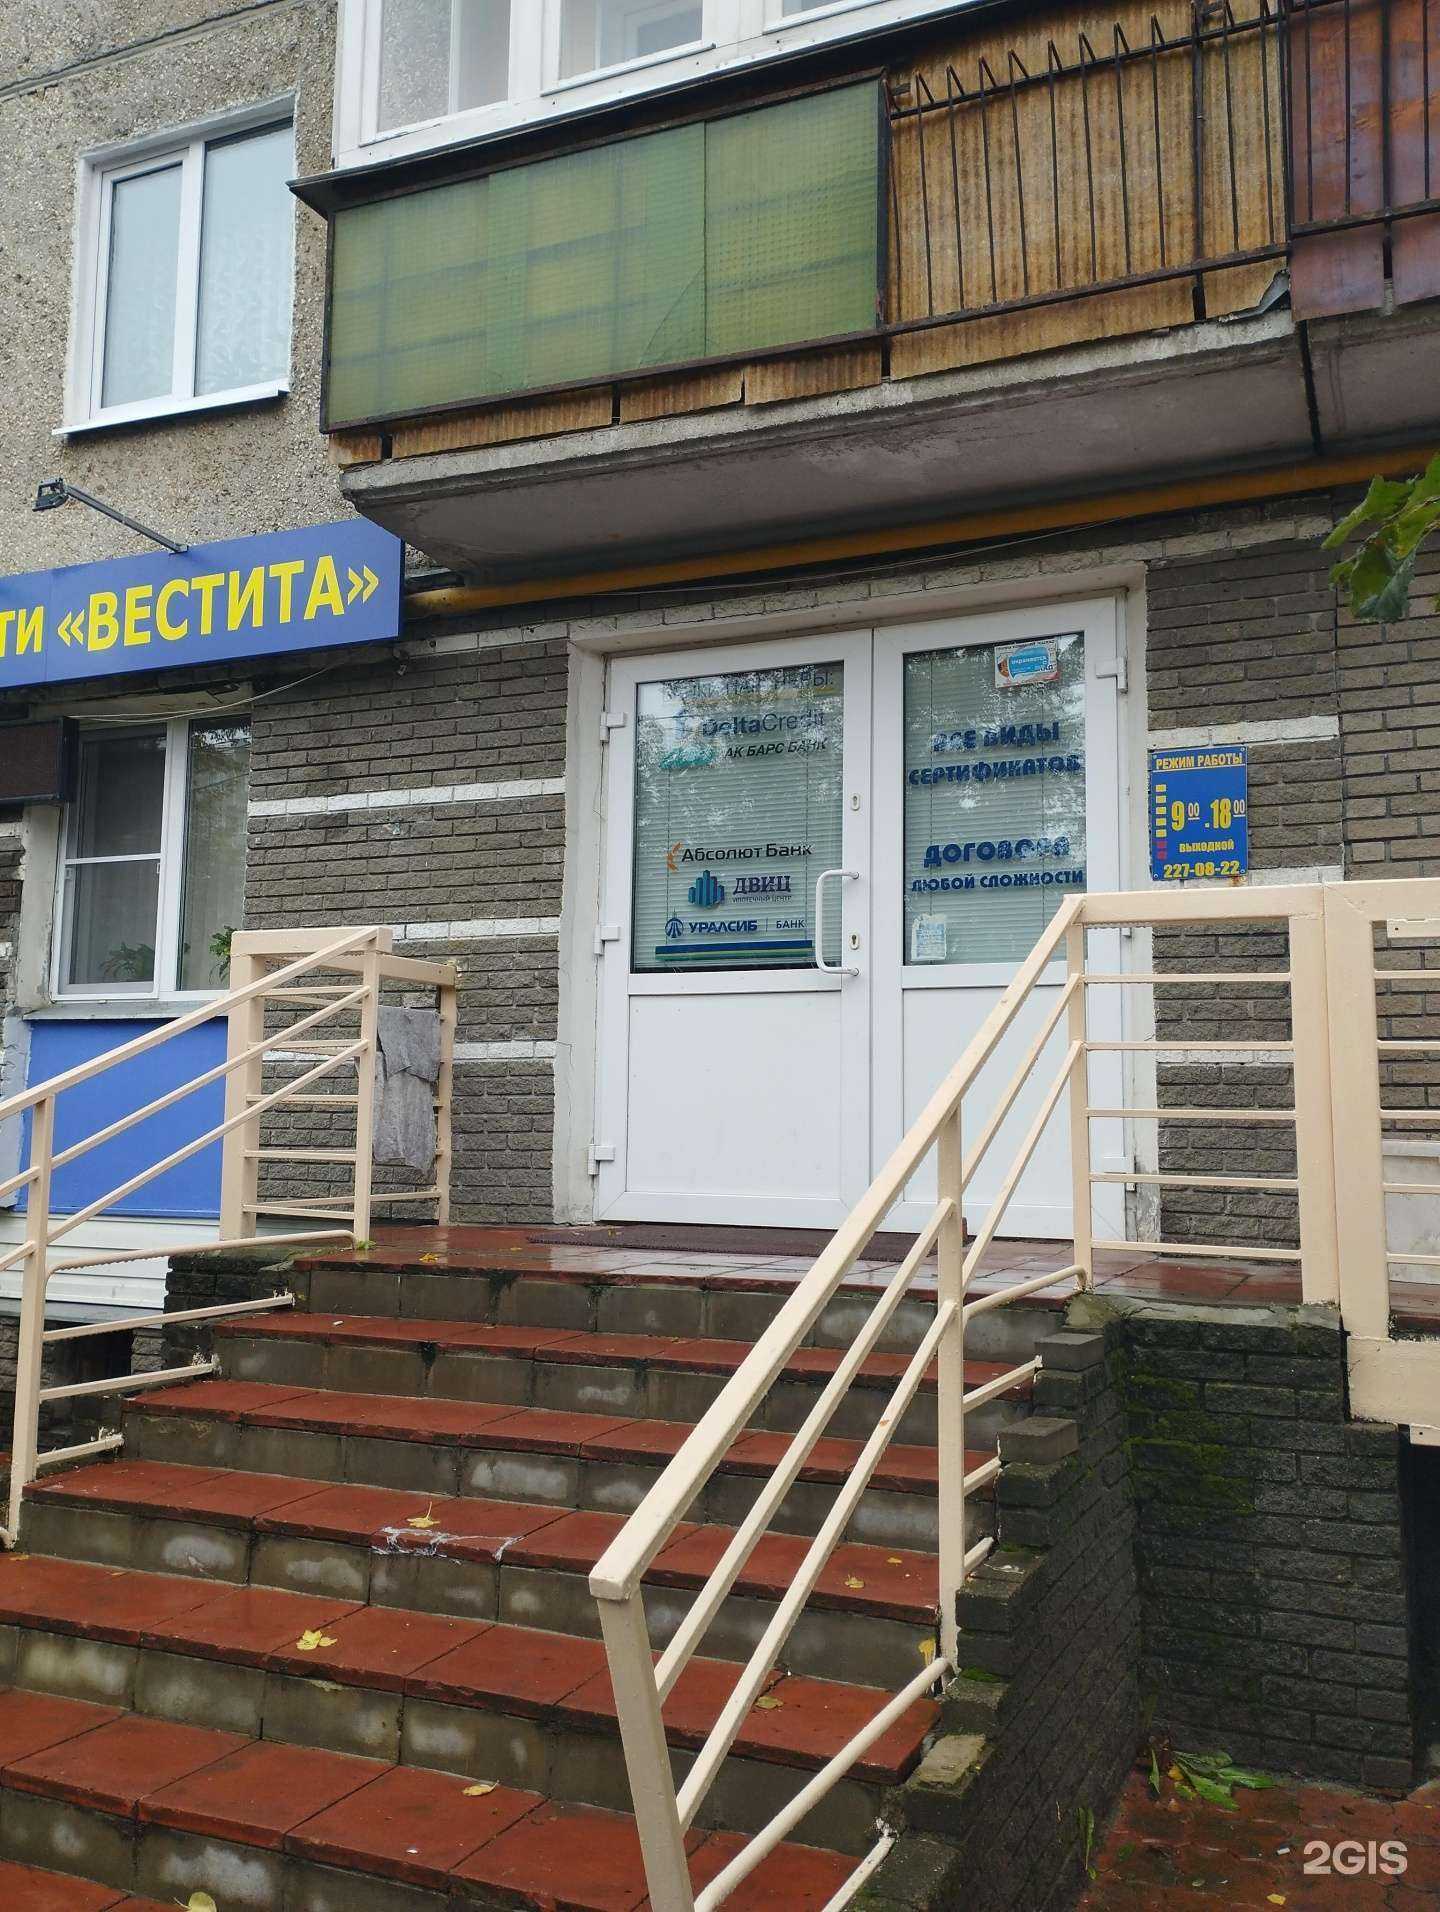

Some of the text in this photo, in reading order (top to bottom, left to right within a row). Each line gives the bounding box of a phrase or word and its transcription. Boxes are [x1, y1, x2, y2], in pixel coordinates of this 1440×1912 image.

[57, 555, 379, 652] «ВЕСТИТА»
[984, 721, 1060, 748] ВИДЫ
[746, 742, 784, 756] БАРС
[788, 738, 828, 753] БАНК
[908, 754, 1082, 786] СЕРТИФИКАТОВ
[1155, 752, 1243, 770] РЕЖИМ РАБОТЫ
[681, 843, 813, 862] Абсолют Банк
[1163, 861, 1240, 878] 227-08-22
[733, 875, 791, 895] ДВИЦ
[911, 870, 1083, 892] ЛЮБОЙ СЛОЖНОСТИ
[688, 919, 806, 933] УРАЛСИБ БАНК
